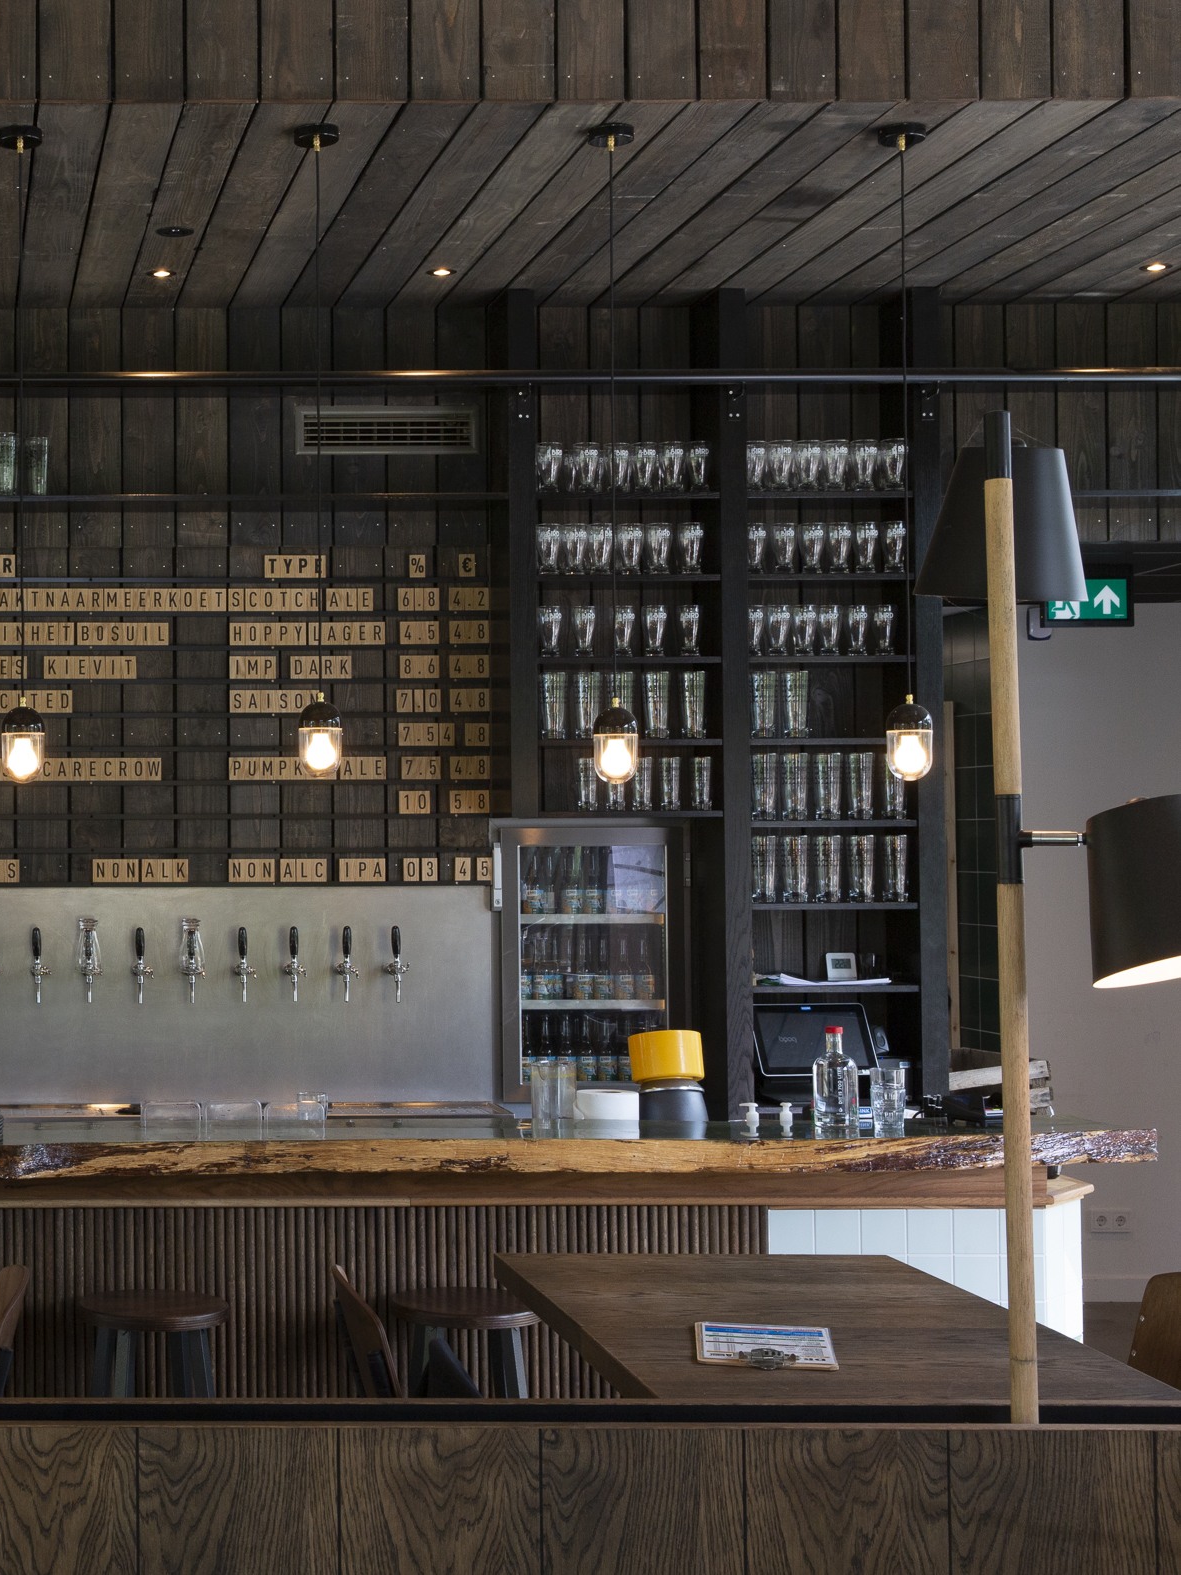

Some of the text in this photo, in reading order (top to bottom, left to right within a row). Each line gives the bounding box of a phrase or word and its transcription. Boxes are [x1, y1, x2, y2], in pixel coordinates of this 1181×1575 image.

[268, 558, 323, 574] TYPE
[411, 557, 424, 573] %
[461, 557, 472, 572] €
[231, 591, 319, 608] SCOTCH
[329, 591, 370, 608] ALE
[402, 591, 436, 607] 6.8
[452, 590, 485, 607] 4.2
[233, 624, 304, 642] HOPPY
[313, 624, 382, 642] LAGER
[404, 624, 435, 641] 4.5
[453, 623, 485, 640] 4.8
[48, 659, 132, 675] KIEVIT
[236, 659, 273, 675] IMP
[294, 659, 349, 675] DARK
[404, 658, 435, 674] 8.6
[453, 658, 485, 674] 4.8
[401, 692, 438, 709] 7.0
[454, 692, 486, 708] 4.8
[43, 760, 161, 777] CARECROW
[233, 760, 315, 776] PUMPK
[344, 759, 383, 776] ALE
[405, 759, 437, 775] 7.5
[454, 759, 486, 775] 4.8
[404, 794, 427, 810] 10
[454, 793, 485, 810] 5.8
[232, 861, 272, 878] NON
[283, 861, 324, 878] ALC
[345, 861, 382, 878] IPA
